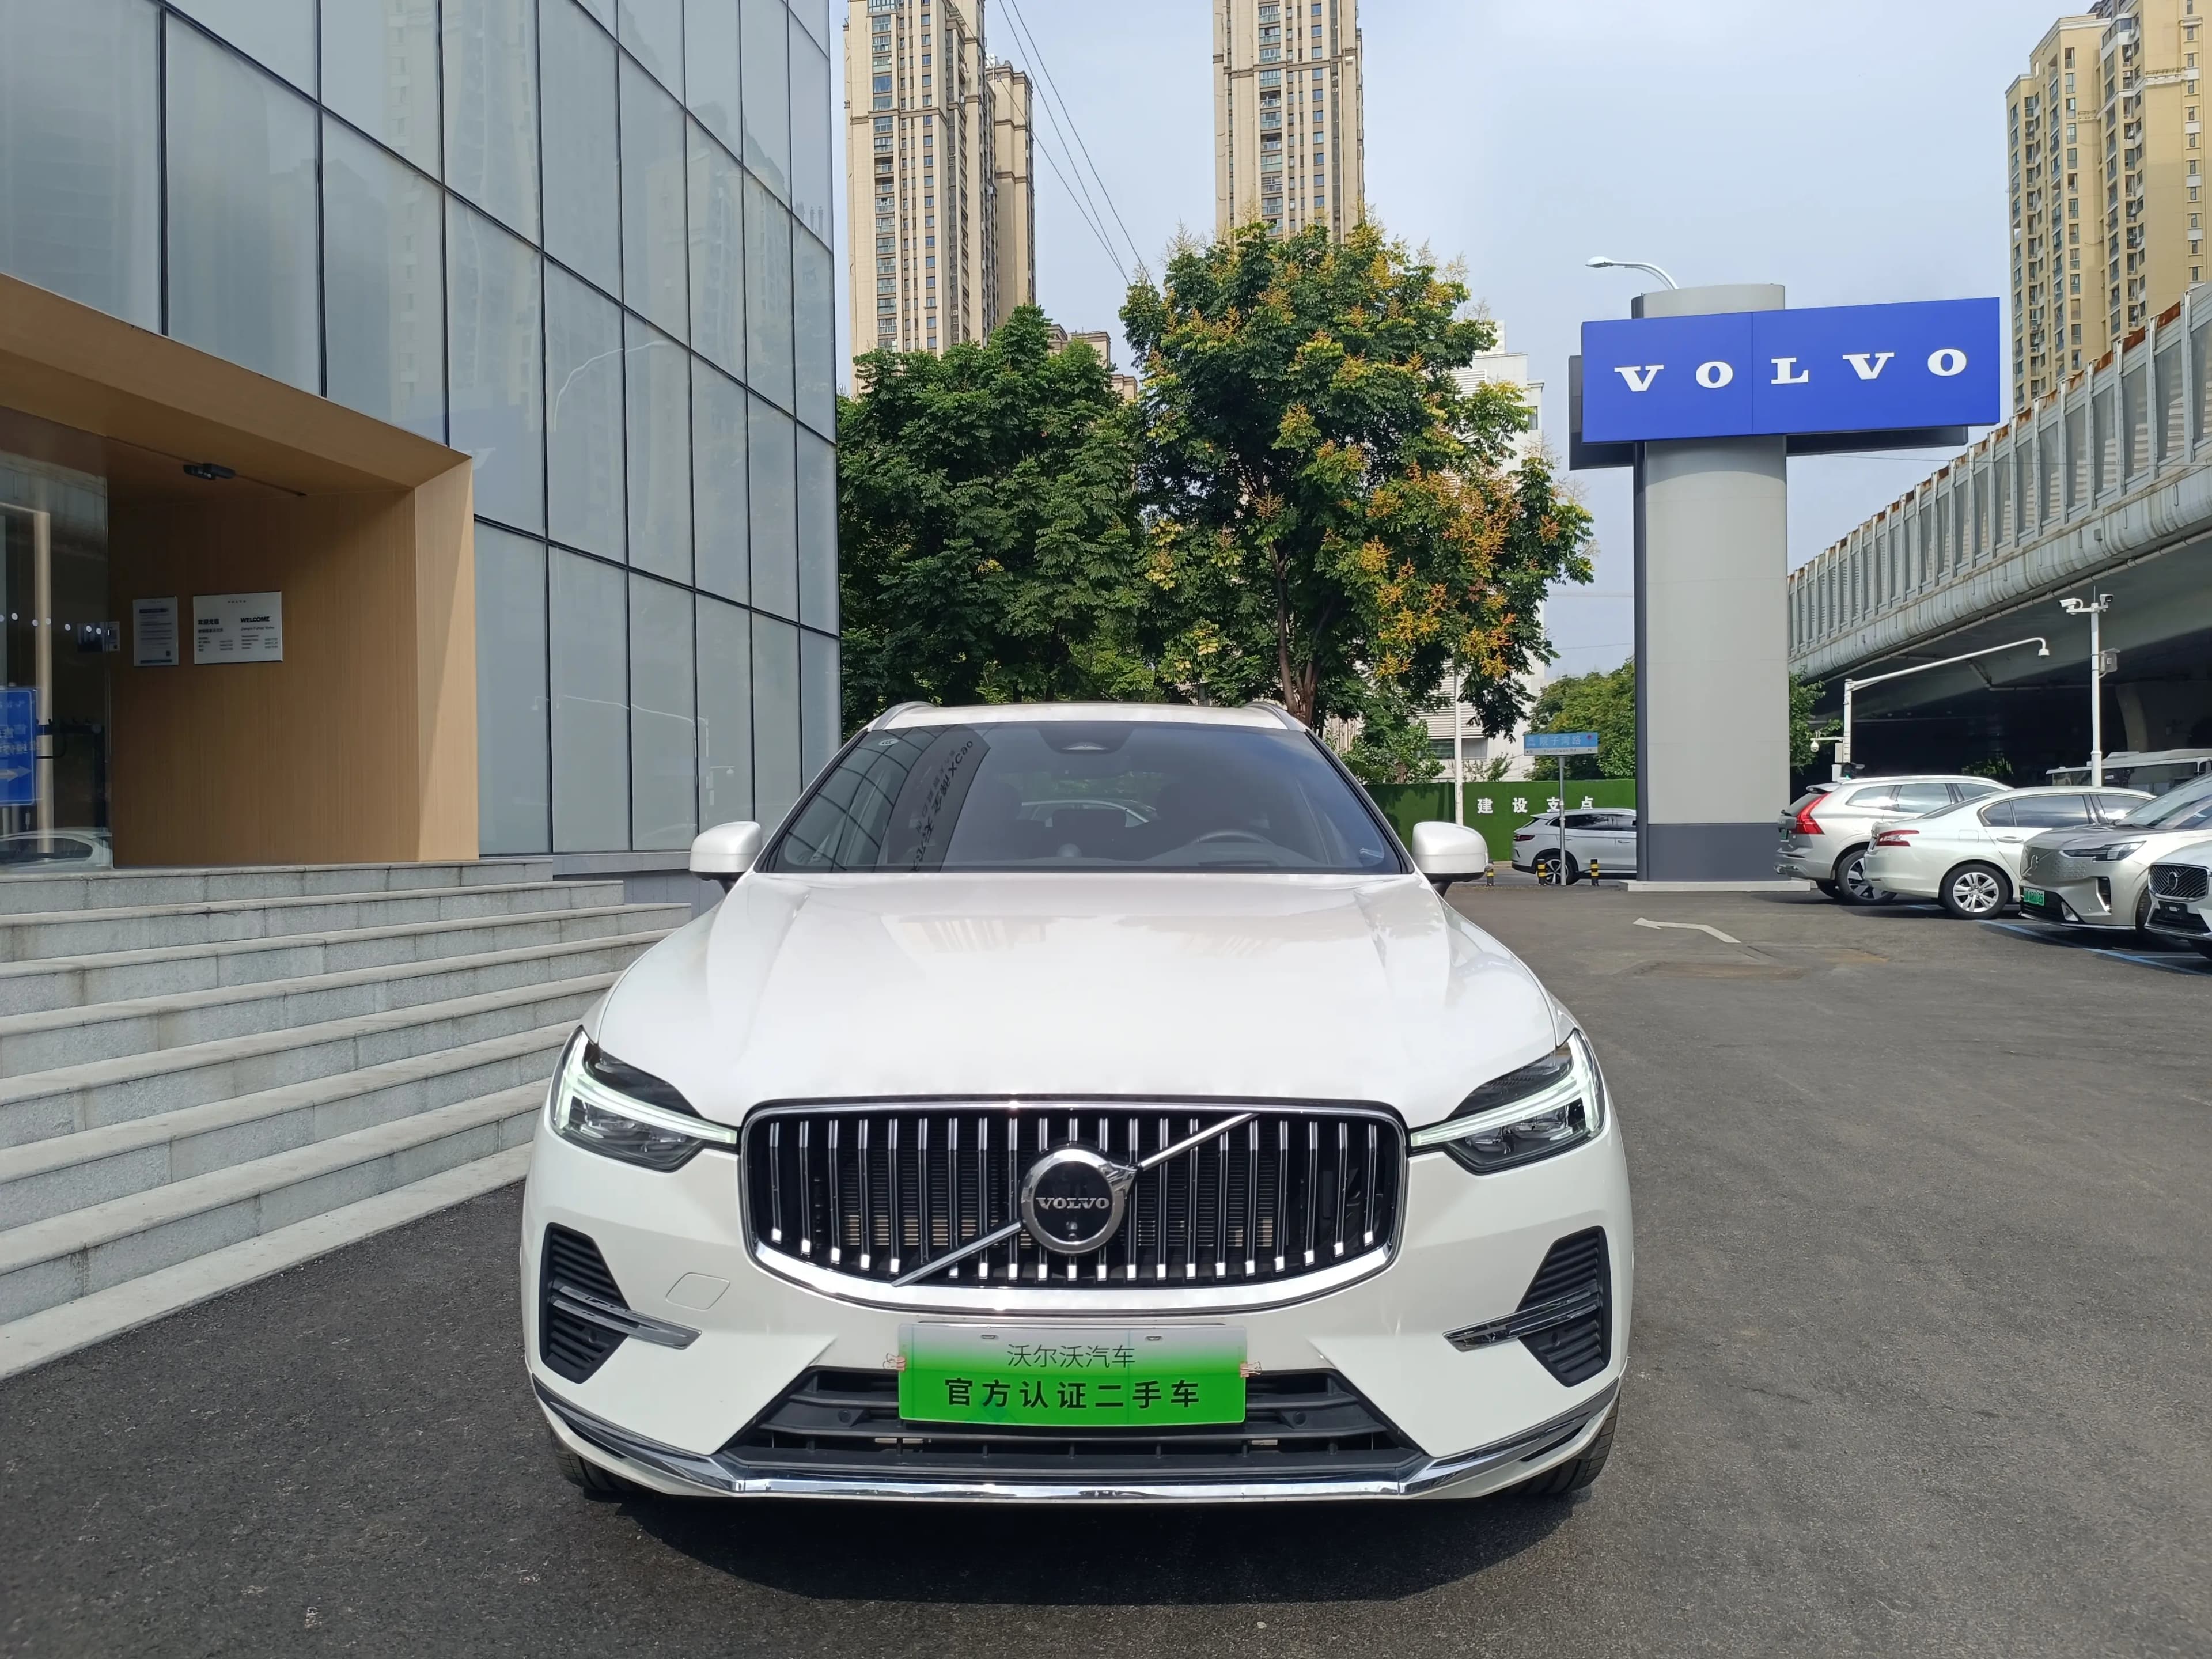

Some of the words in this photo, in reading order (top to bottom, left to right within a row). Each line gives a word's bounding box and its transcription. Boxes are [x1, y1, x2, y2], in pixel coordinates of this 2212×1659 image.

[1615, 349, 1967, 392] VOLVO
[1036, 1197, 1109, 1209] VOLVO
[1007, 1344, 1135, 1369] 沃尔沃汽车
[944, 1377, 1199, 1409] 官方认证二手车
